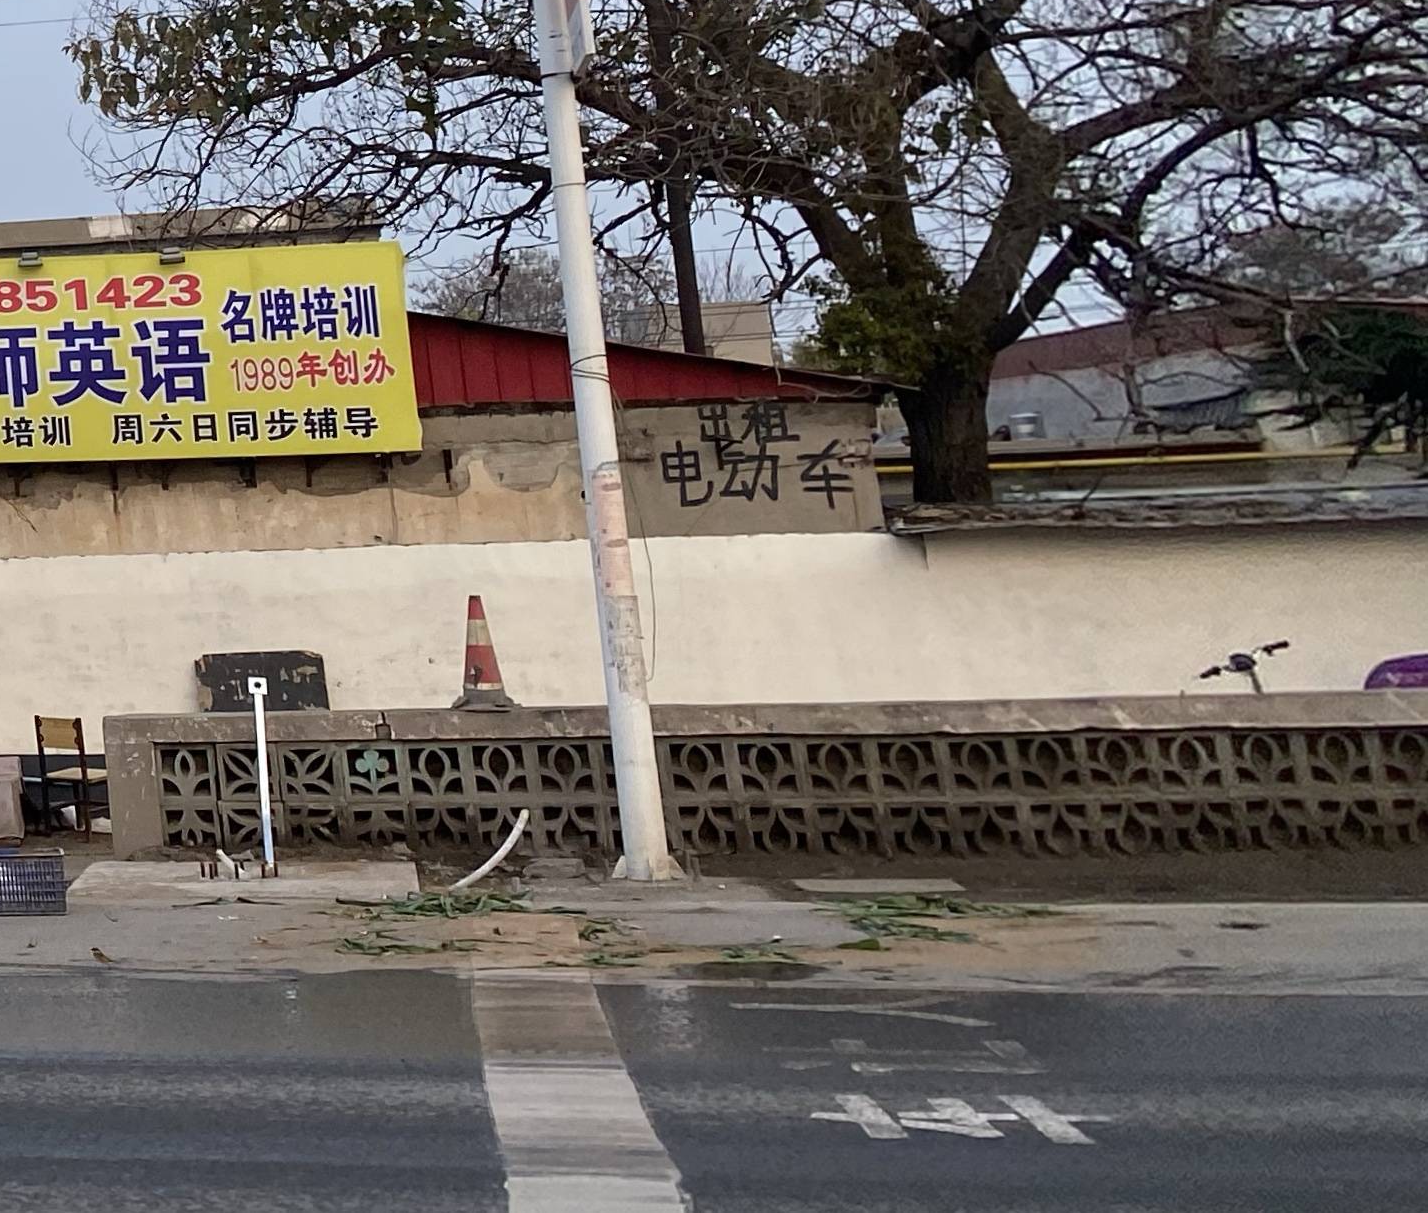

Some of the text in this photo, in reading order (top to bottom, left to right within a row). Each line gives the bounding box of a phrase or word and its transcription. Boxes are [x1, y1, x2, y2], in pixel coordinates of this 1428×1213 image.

[220, 284, 382, 344] 名牌培训
[227, 348, 397, 393] 1989年创办
[111, 407, 380, 448] 周六日同步辅导
[661, 439, 855, 510] 电动车
